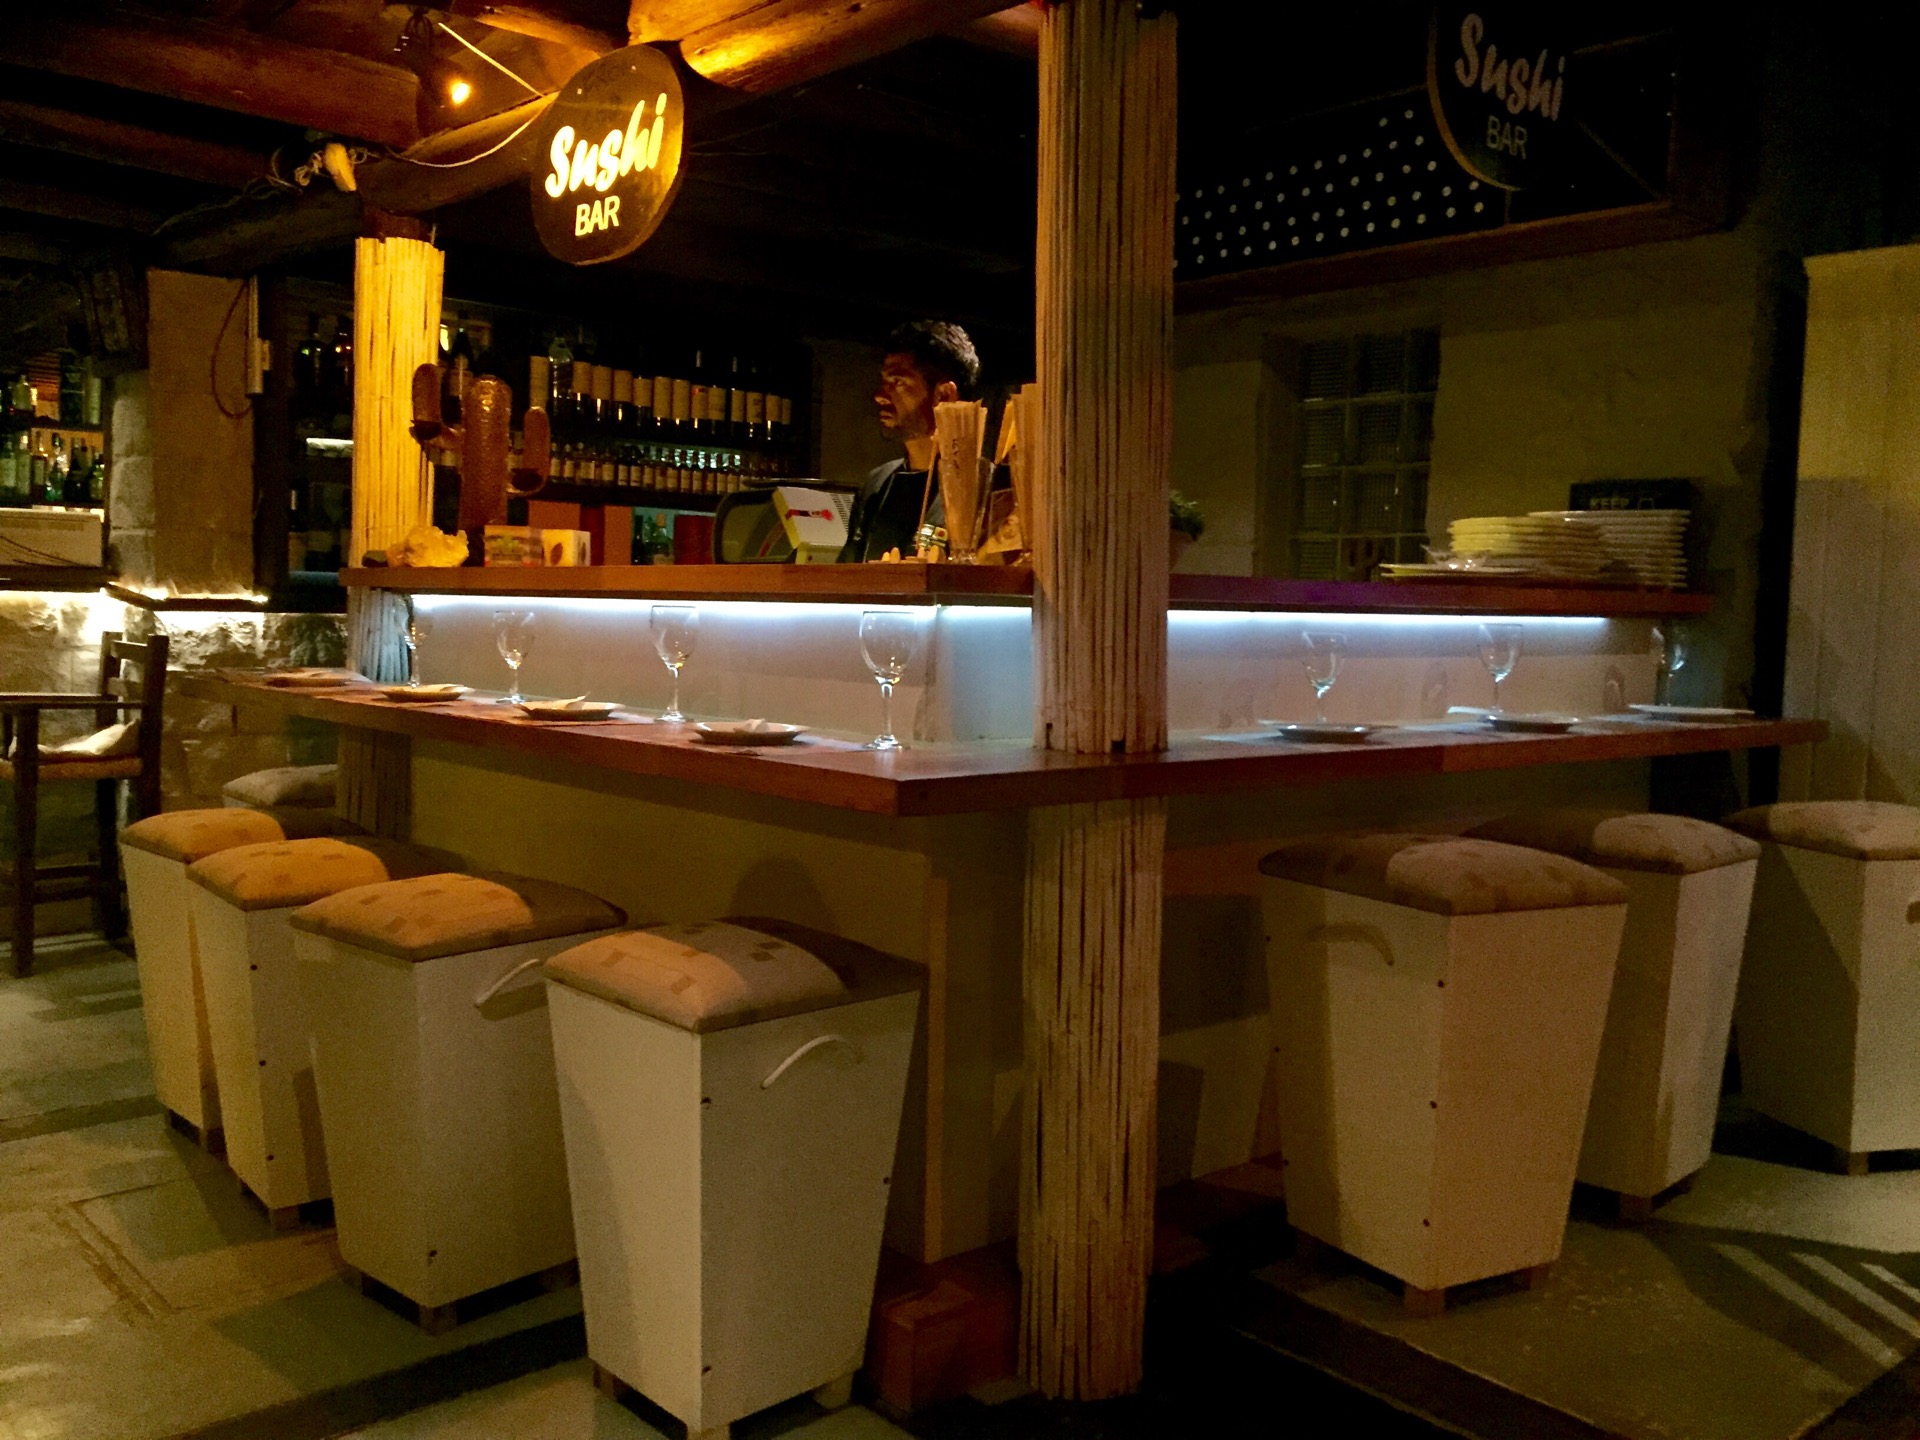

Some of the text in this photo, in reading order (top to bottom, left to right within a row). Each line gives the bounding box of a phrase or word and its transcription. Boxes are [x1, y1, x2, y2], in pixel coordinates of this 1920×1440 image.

[1454, 12, 1567, 122] Sushi
[545, 92, 667, 198] Sushi
[1486, 114, 1528, 160] BAR
[575, 195, 620, 236] BAR
